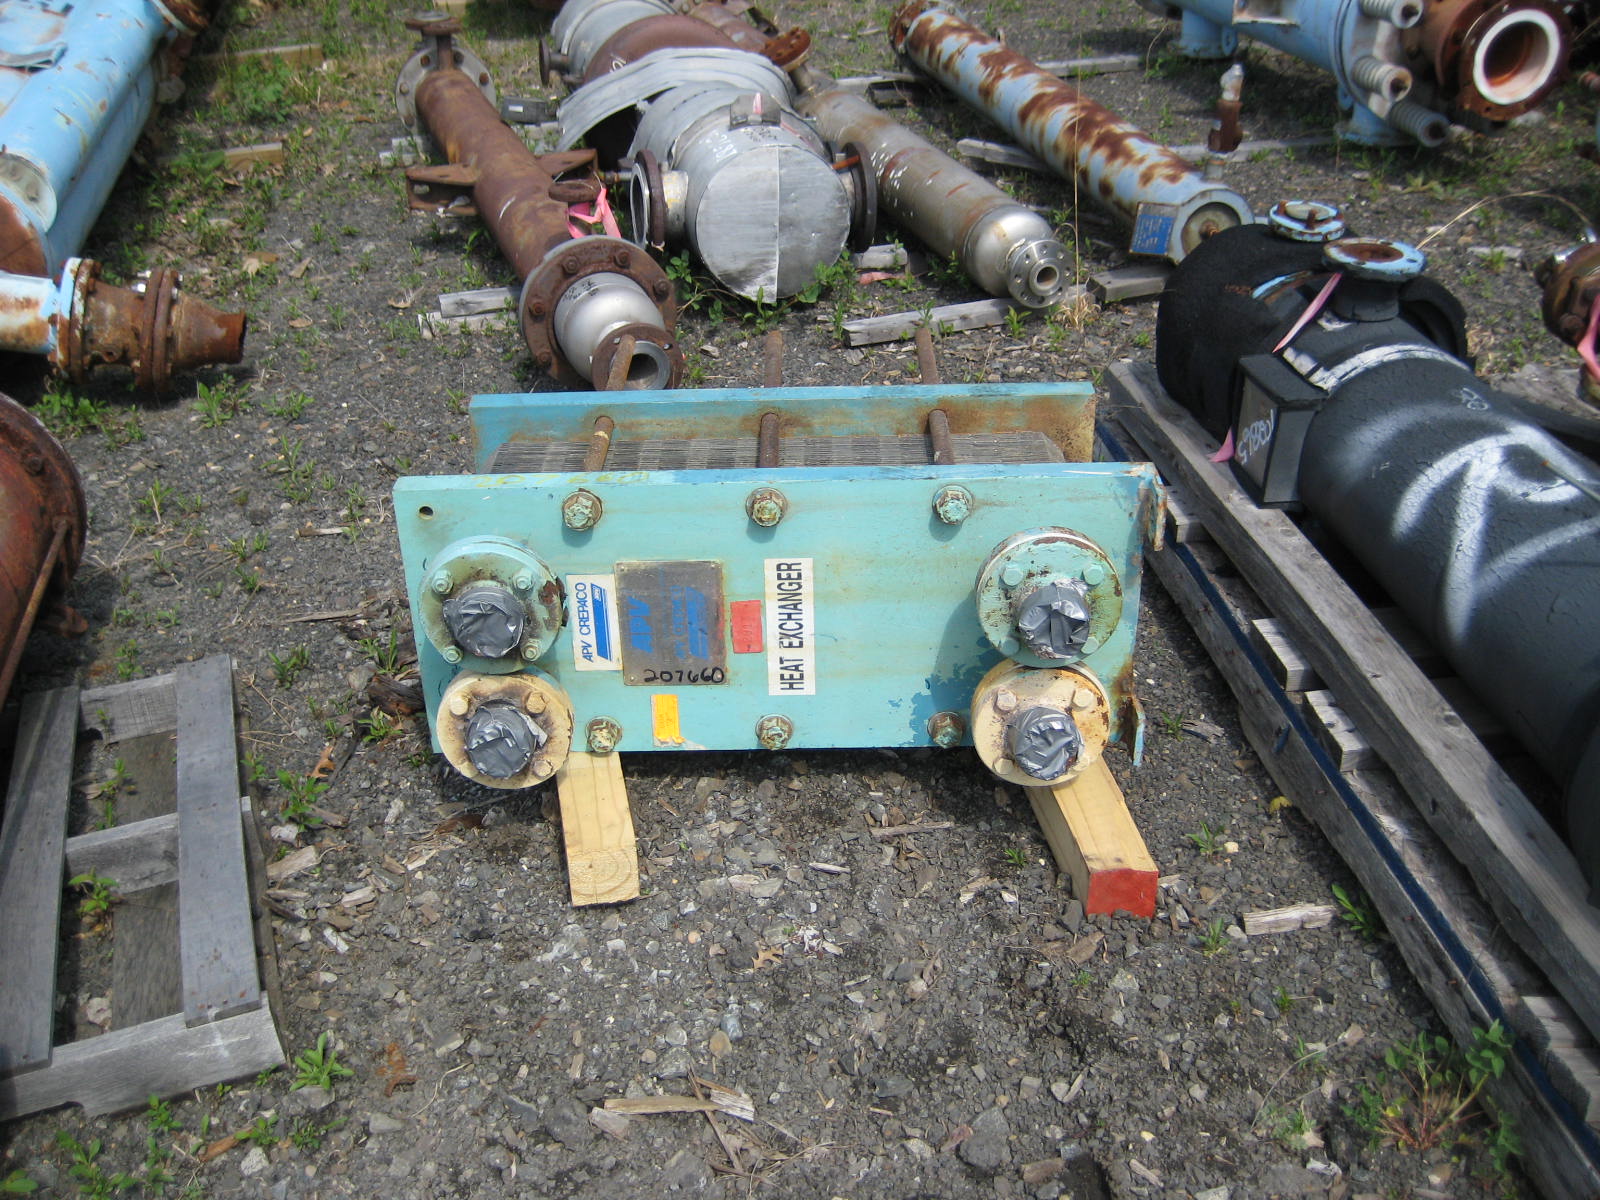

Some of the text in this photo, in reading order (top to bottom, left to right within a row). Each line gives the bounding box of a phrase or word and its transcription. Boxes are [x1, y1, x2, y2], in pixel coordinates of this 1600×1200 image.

[575, 582, 594, 663] APV CREPACO
[626, 596, 654, 654] APV
[776, 562, 805, 691] HEAT EXCHANGER
[643, 667, 724, 684] 207660
